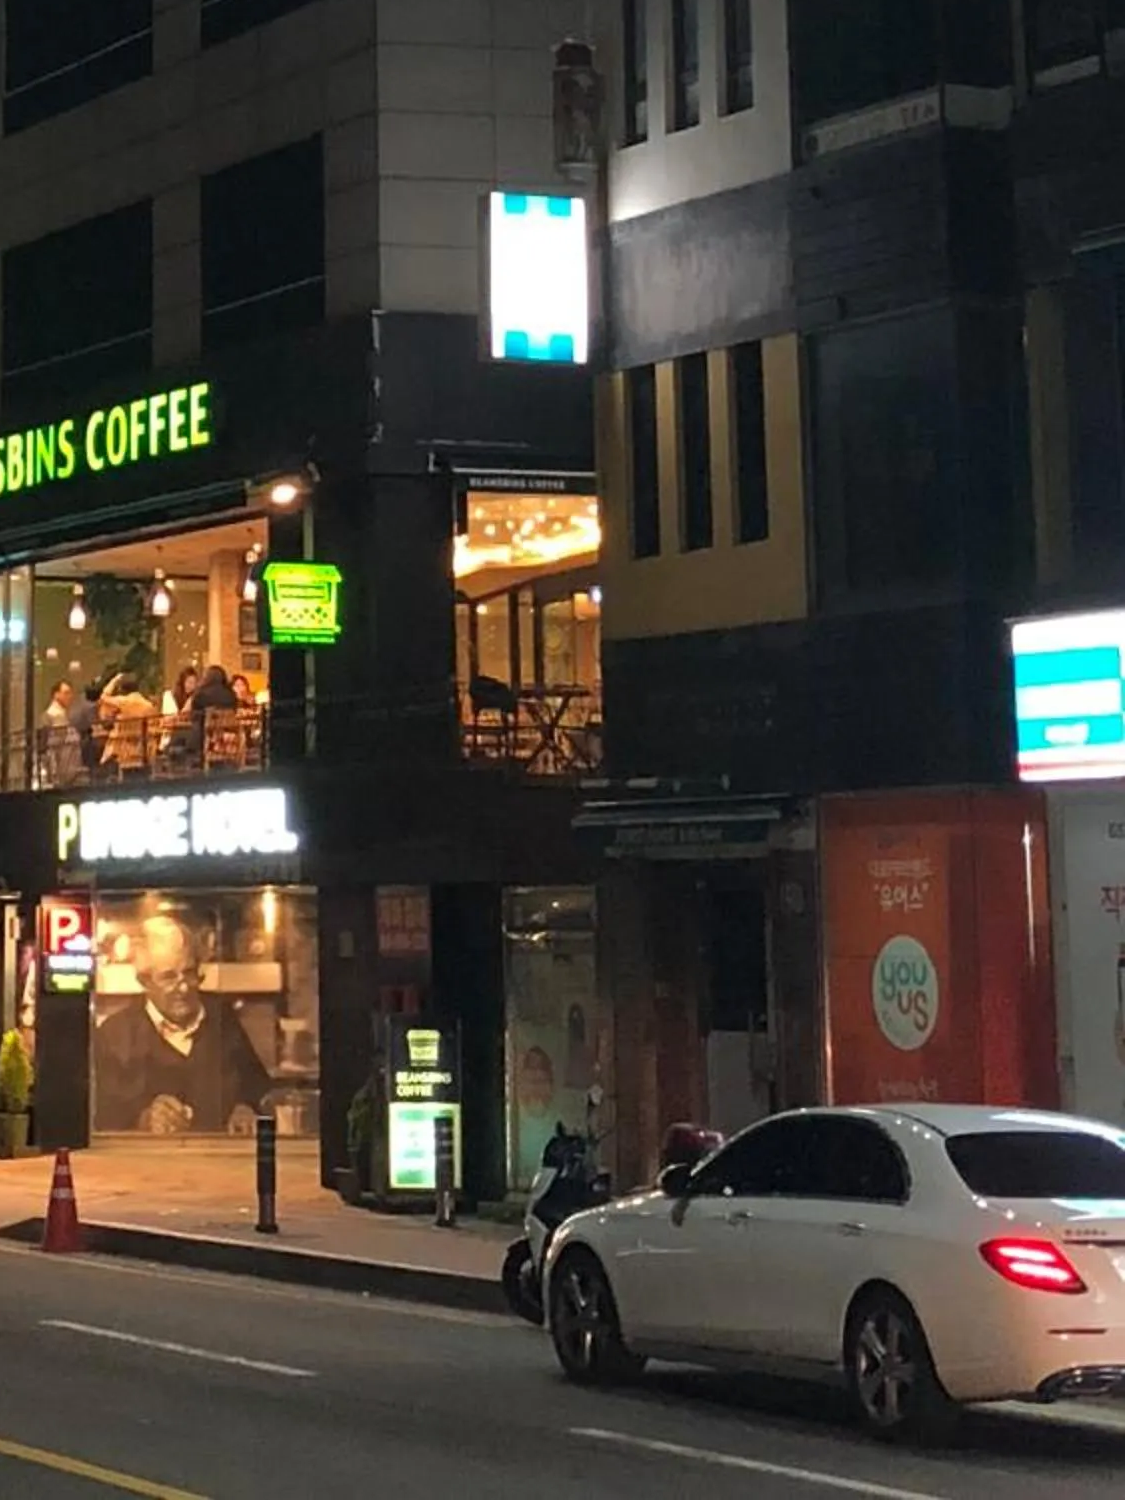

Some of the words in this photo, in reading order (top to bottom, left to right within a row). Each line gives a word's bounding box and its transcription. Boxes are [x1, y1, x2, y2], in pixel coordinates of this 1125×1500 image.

[86, 382, 210, 471] COFFEE
[50, 907, 80, 952] P
[881, 960, 927, 1002] you
